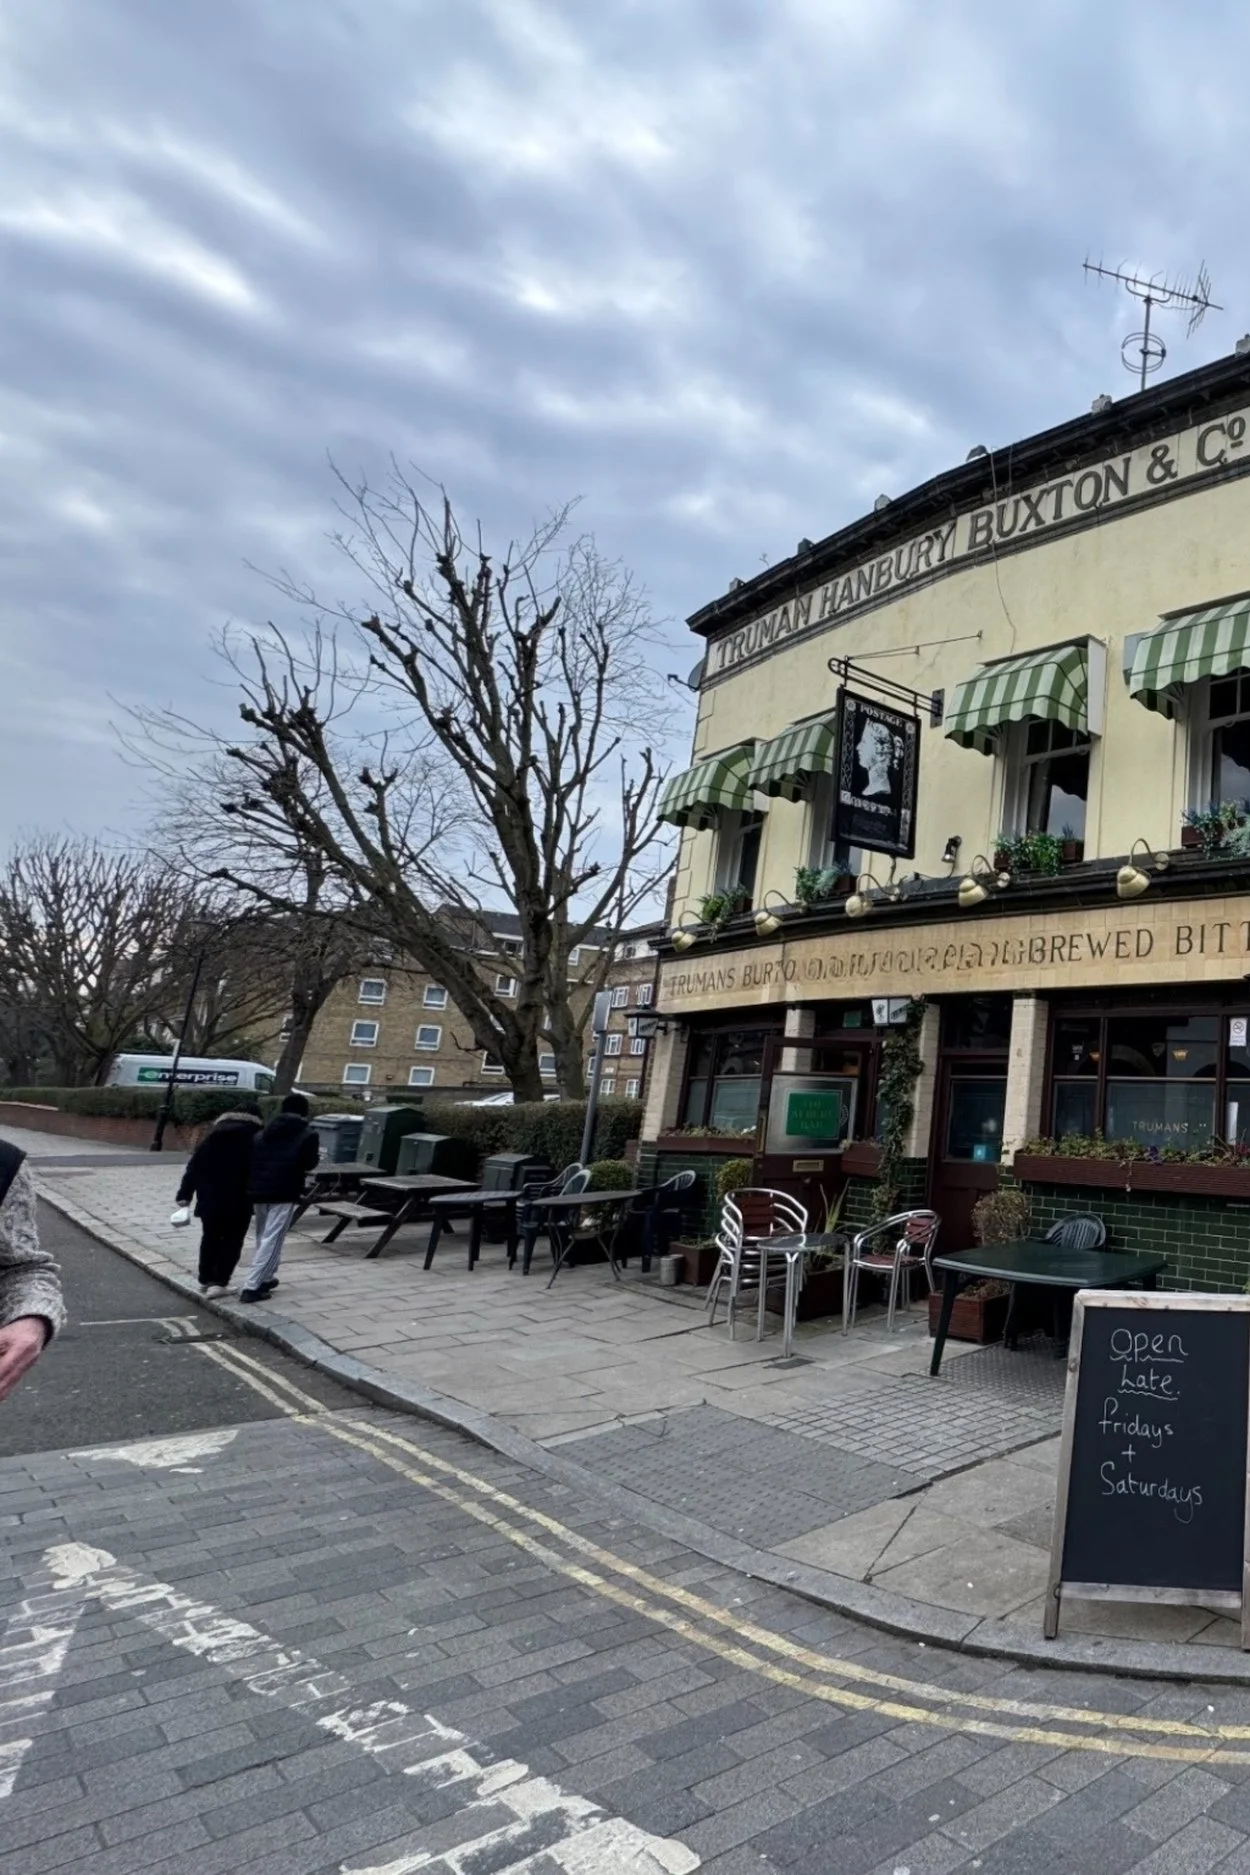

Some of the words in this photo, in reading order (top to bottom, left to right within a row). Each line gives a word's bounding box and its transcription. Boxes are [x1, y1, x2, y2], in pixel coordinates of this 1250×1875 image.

[716, 594, 813, 669] TRUMAN
[819, 521, 956, 619] HANBURY
[966, 456, 1132, 551] BUXTON
[1146, 443, 1178, 484] &
[670, 967, 736, 996] TRUMANS
[1028, 928, 1154, 965] BREWED
[141, 1070, 238, 1082] enerprise
[1132, 1120, 1189, 1134] TRUMANS
[1111, 1328, 1188, 1363] Open
[1101, 1461, 1203, 1523] Saturdays
